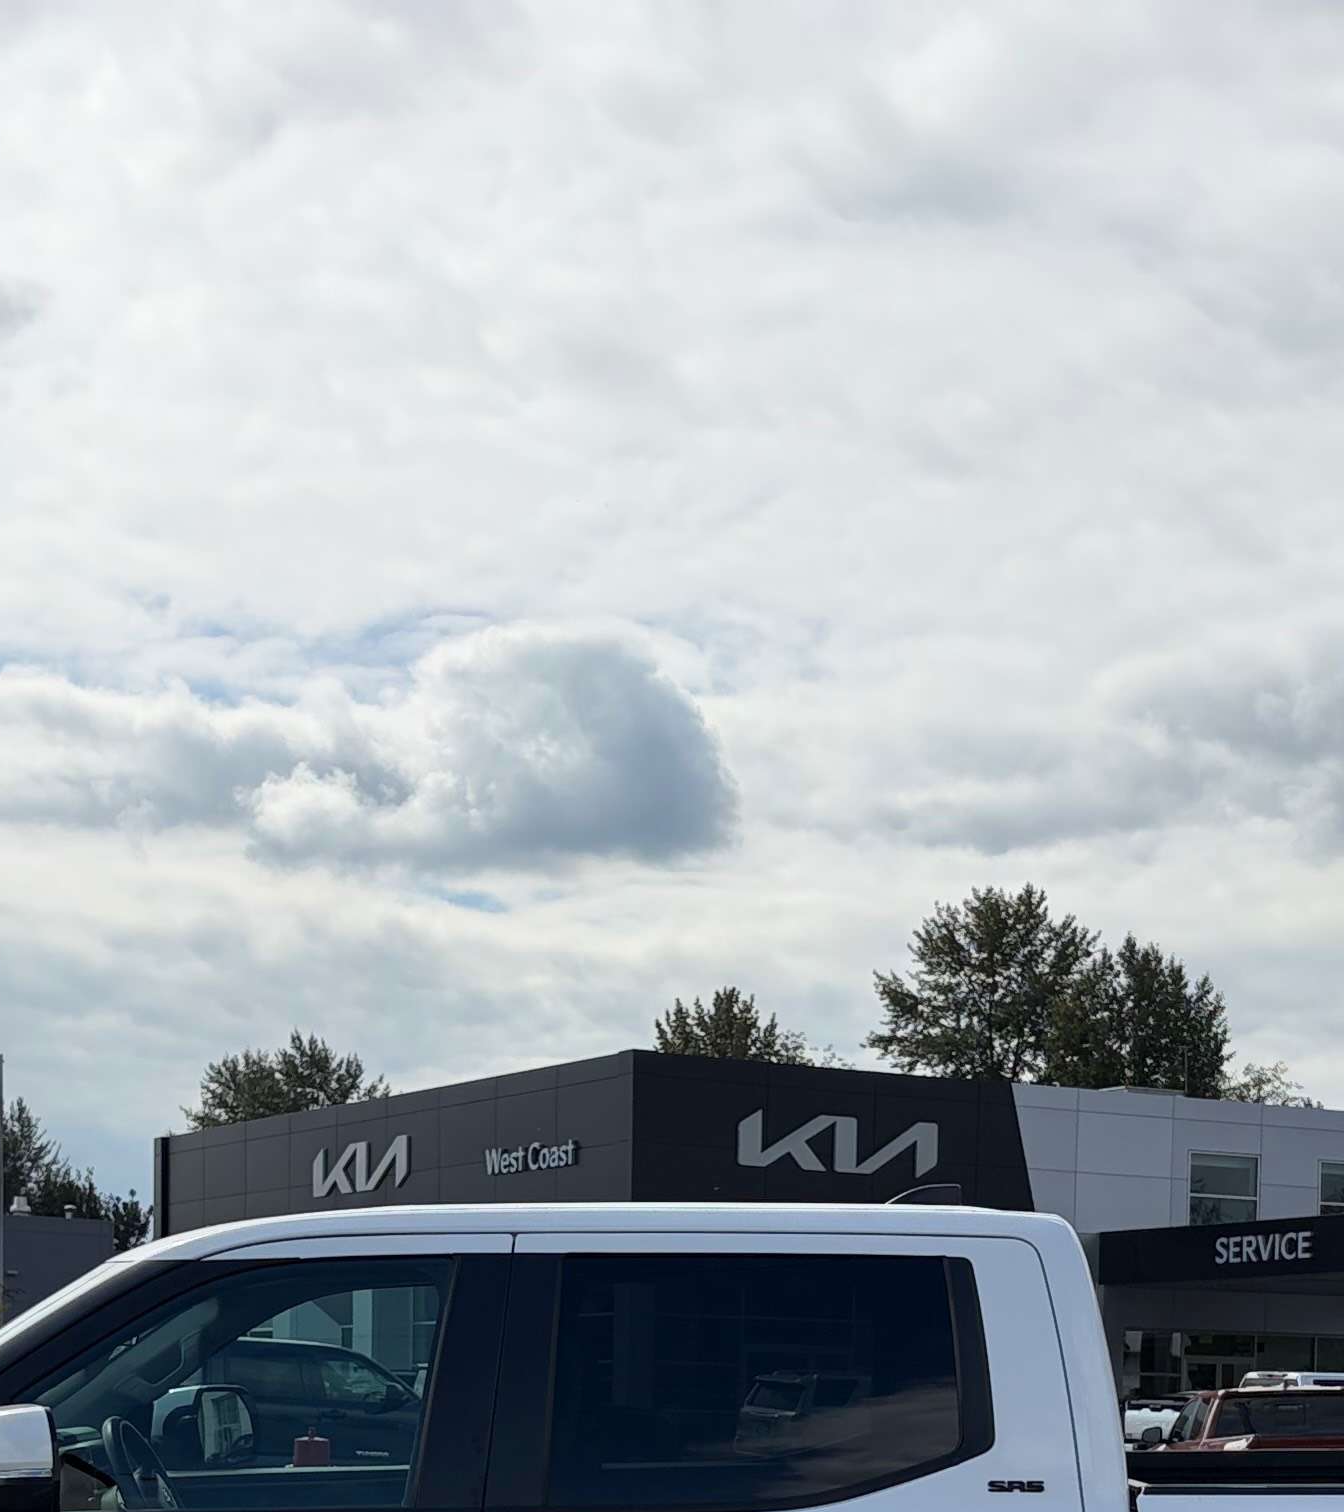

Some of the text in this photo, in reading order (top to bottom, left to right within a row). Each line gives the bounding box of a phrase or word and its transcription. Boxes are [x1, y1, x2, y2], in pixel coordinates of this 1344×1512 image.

[485, 1139, 576, 1176] West Coast
[737, 1108, 939, 1179] KIA
[313, 1134, 411, 1198] KIA
[1215, 1231, 1313, 1264] SERVICE
[987, 1480, 1045, 1493] SR5
